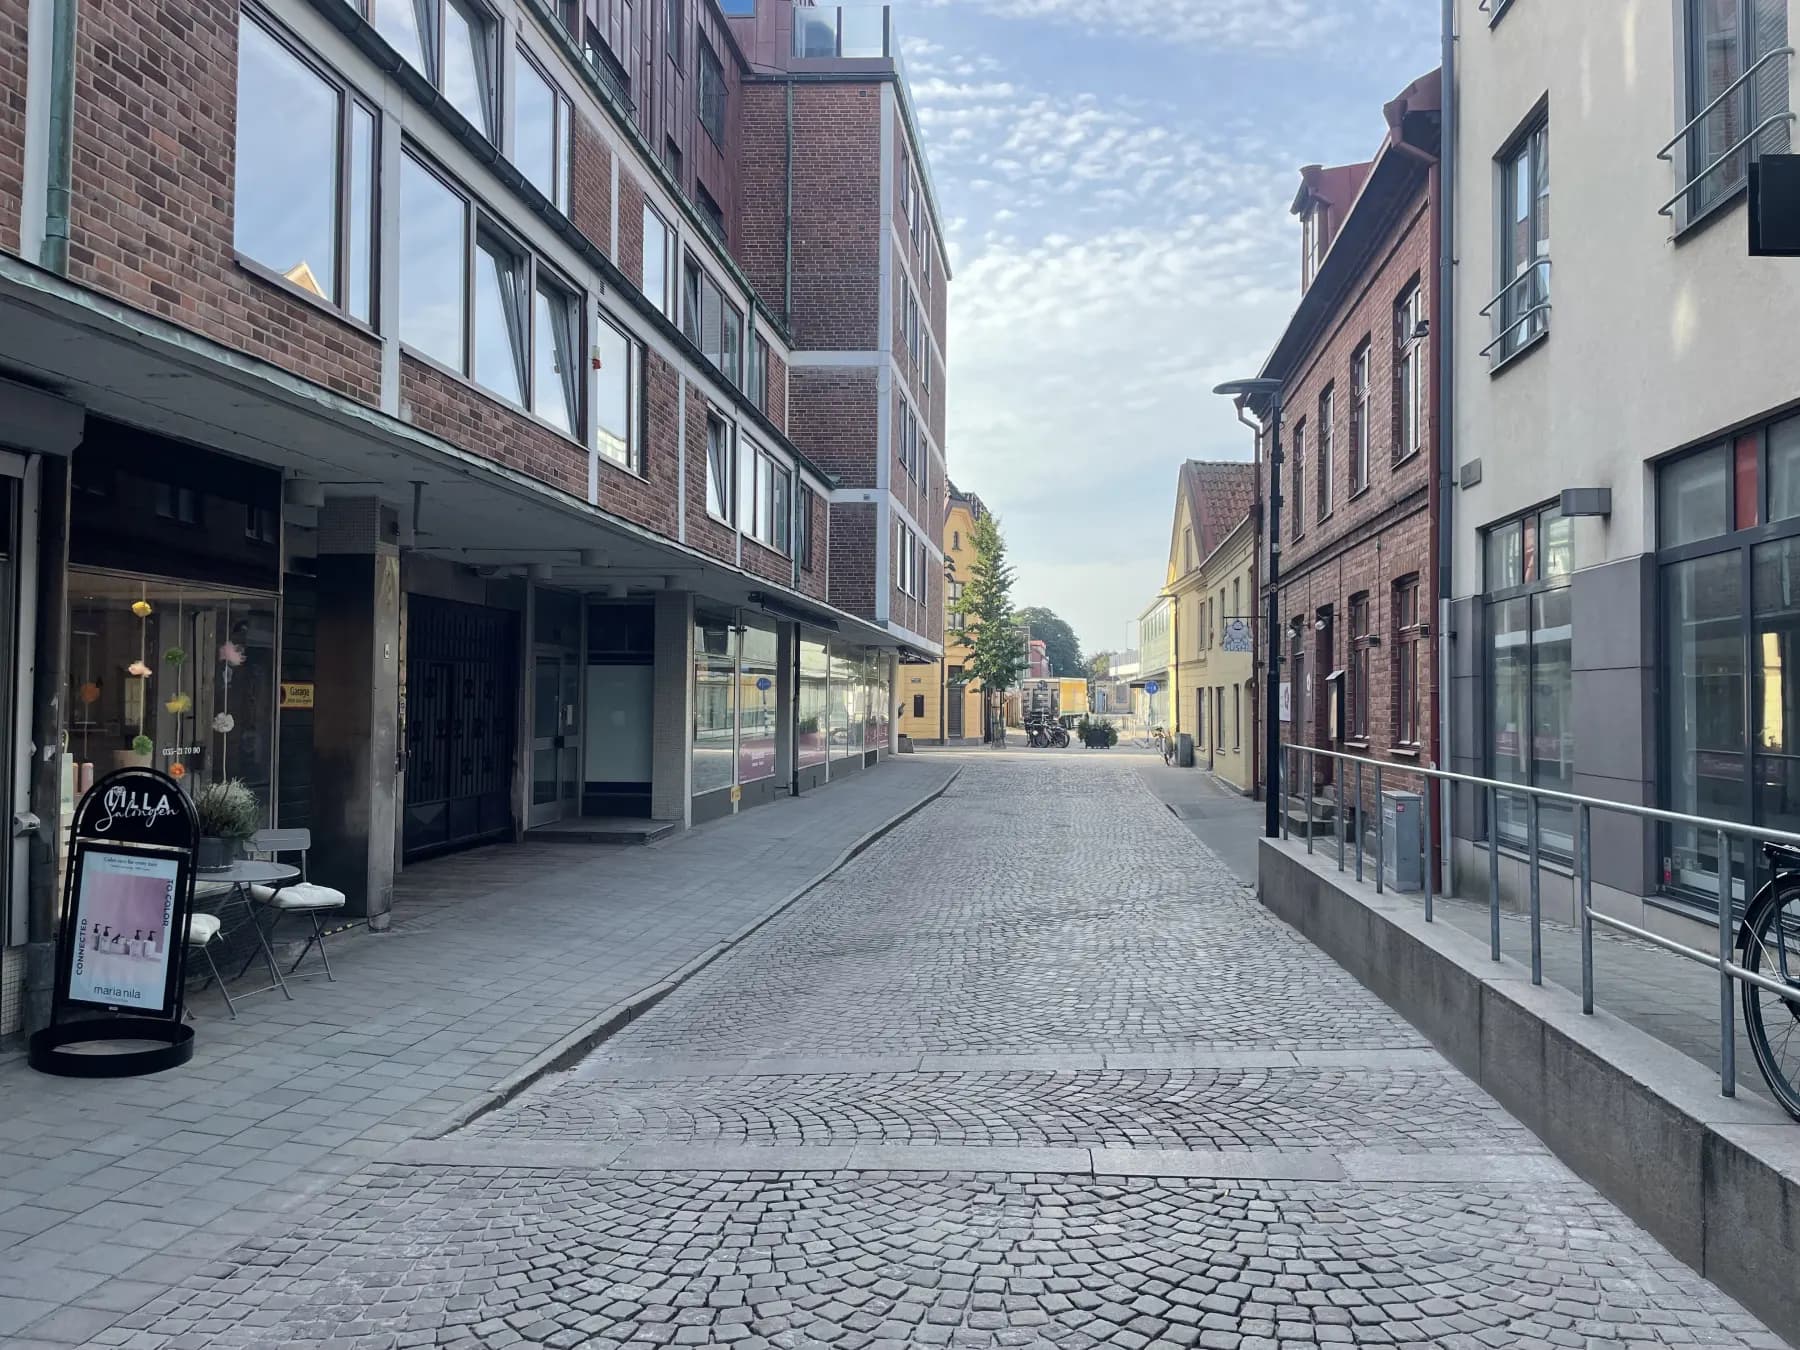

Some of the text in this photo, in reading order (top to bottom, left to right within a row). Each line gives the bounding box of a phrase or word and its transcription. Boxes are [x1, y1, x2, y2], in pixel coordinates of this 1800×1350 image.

[76, 918, 88, 976] CONNECTED
[93, 985, 141, 999] maria nila
